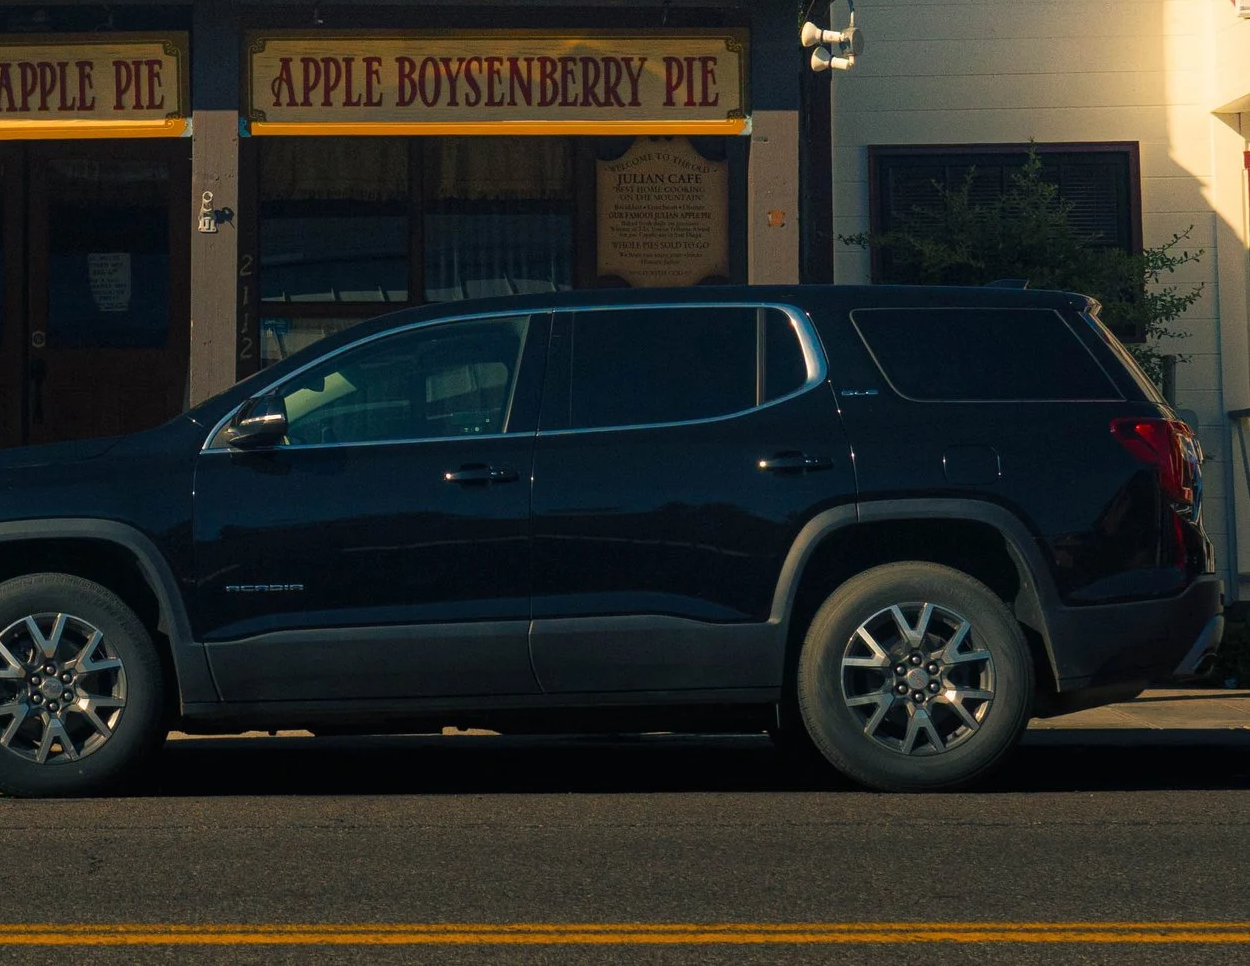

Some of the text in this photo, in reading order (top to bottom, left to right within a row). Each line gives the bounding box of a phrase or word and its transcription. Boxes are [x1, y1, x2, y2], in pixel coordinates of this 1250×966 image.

[112, 59, 165, 111] PIE
[270, 55, 721, 108] APPLE BOYSENBERRY PIE
[617, 174, 703, 185] JULIAN CAFE
